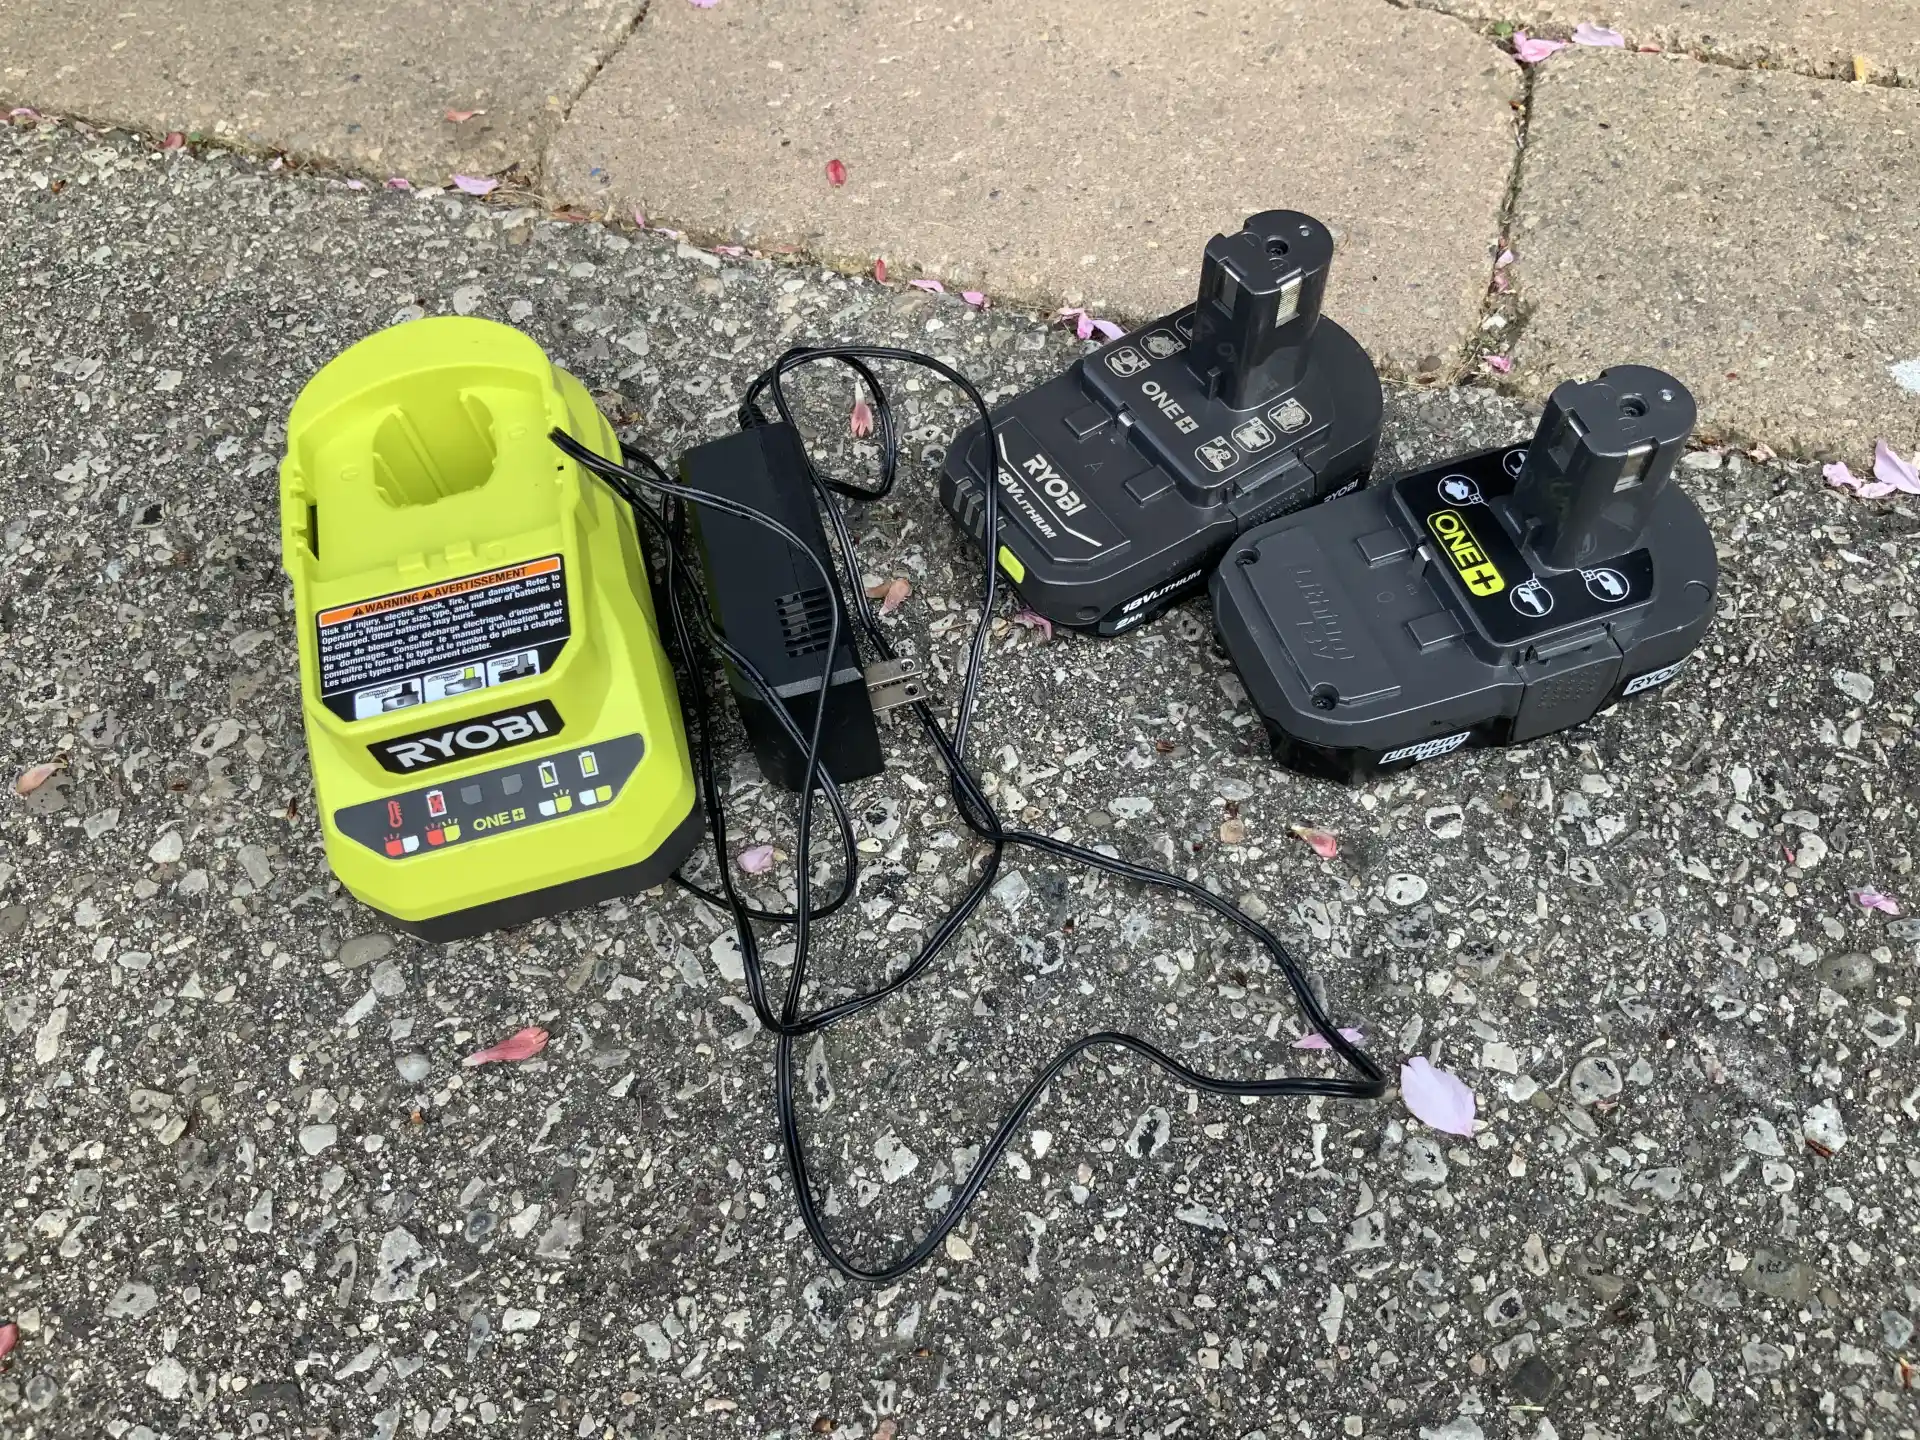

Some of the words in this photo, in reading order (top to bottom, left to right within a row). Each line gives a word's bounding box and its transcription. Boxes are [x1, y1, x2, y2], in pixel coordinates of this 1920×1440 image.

[1022, 453, 1087, 517] RYOBI
[1435, 515, 1498, 591] ONE+
[321, 625, 339, 637] Risk
[343, 622, 351, 631] of
[355, 617, 380, 628] injury,
[384, 608, 414, 622] electric
[418, 601, 445, 614] shock,
[448, 597, 465, 606] fire,
[468, 590, 484, 602] and
[488, 584, 522, 597] damage.
[525, 577, 547, 588] Refer
[551, 573, 559, 582] to
[321, 628, 363, 646] Operator's
[365, 620, 395, 634] Manual
[397, 618, 410, 627] for
[411, 614, 430, 623] size,
[431, 609, 452, 619] type,
[453, 602, 469, 613] and
[470, 596, 502, 609] number
[504, 592, 512, 601] of
[514, 584, 550, 599] batteries
[552, 581, 560, 590] to
[365, 593, 420, 613] WARNING
[434, 566, 528, 597] AVERTISSEMENT
[322, 651, 350, 663] Risque
[354, 647, 364, 656] de
[367, 638, 405, 652] blessure,
[408, 634, 418, 643] de
[421, 624, 460, 639] décharge
[462, 614, 506, 629] électrique,
[508, 601, 550, 618] d'incendie
[553, 597, 562, 607] et
[322, 644, 332, 653] be
[334, 635, 370, 650] charged.
[371, 630, 393, 641] Other
[395, 621, 431, 635] batteries
[432, 616, 450, 626] may
[452, 609, 476, 622] burst.
[323, 662, 334, 671] de
[339, 651, 388, 667] dommages.
[393, 639, 433, 654] Consulter
[438, 635, 447, 644] le
[452, 625, 483, 640] manuel
[488, 614, 538, 632] d'utilisation
[543, 608, 563, 620] pour
[323, 664, 362, 680] connaître
[364, 661, 372, 670] le
[374, 654, 404, 667] format,
[406, 651, 414, 660] le
[415, 647, 434, 658] type
[435, 643, 444, 653] et
[446, 641, 454, 650] le
[455, 634, 487, 648] nombre
[489, 631, 500, 640] de
[501, 626, 521, 638] piles
[523, 623, 528, 631] à
[530, 617, 564, 630] charger.
[324, 678, 339, 688] Les
[340, 672, 367, 684] autres
[368, 666, 391, 678] types
[393, 662, 404, 671] de
[405, 657, 425, 670] piles
[427, 647, 460, 664] peuvent
[461, 642, 491, 654] éclater.
[385, 710, 549, 767] RYOBI
[472, 807, 526, 831] ONE+
